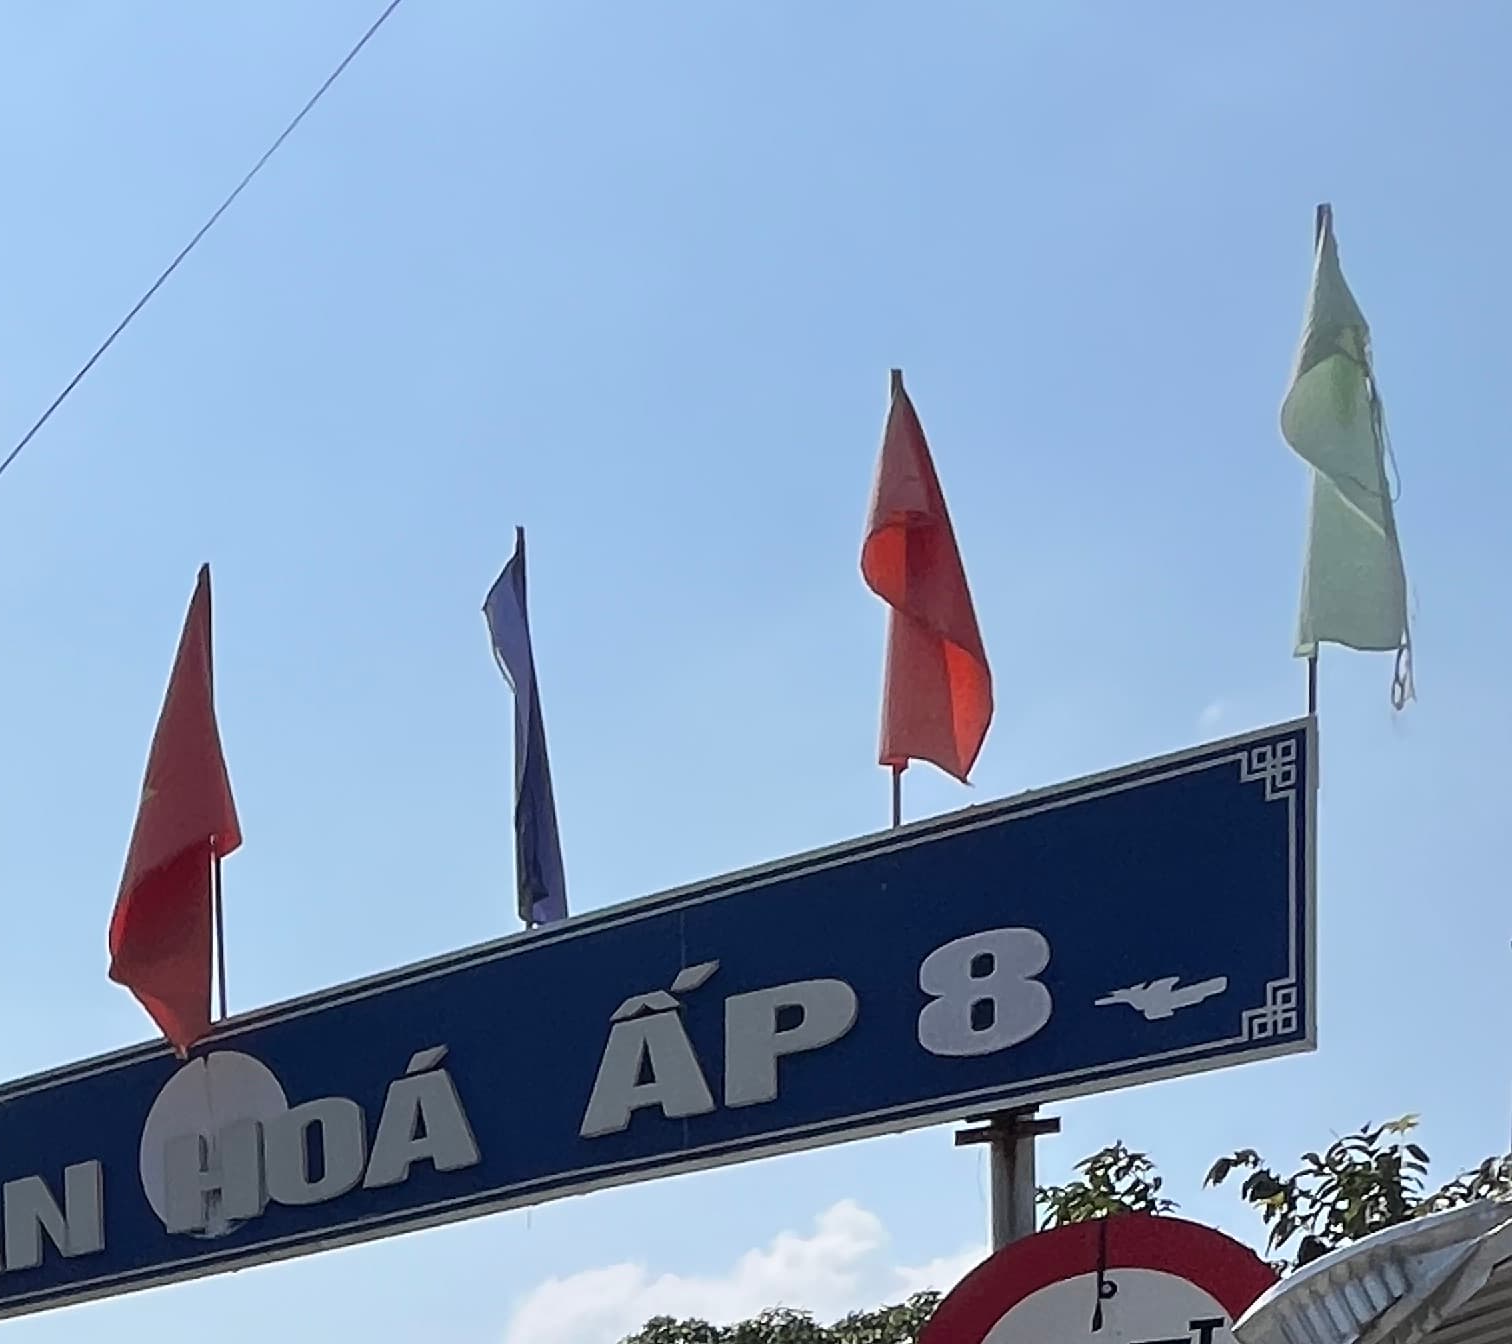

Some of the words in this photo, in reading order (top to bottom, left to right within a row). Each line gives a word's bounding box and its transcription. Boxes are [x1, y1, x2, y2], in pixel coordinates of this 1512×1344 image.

[163, 1044, 482, 1237] HOÁ
[578, 958, 859, 1139] ẤP
[916, 926, 1053, 1057] 8
